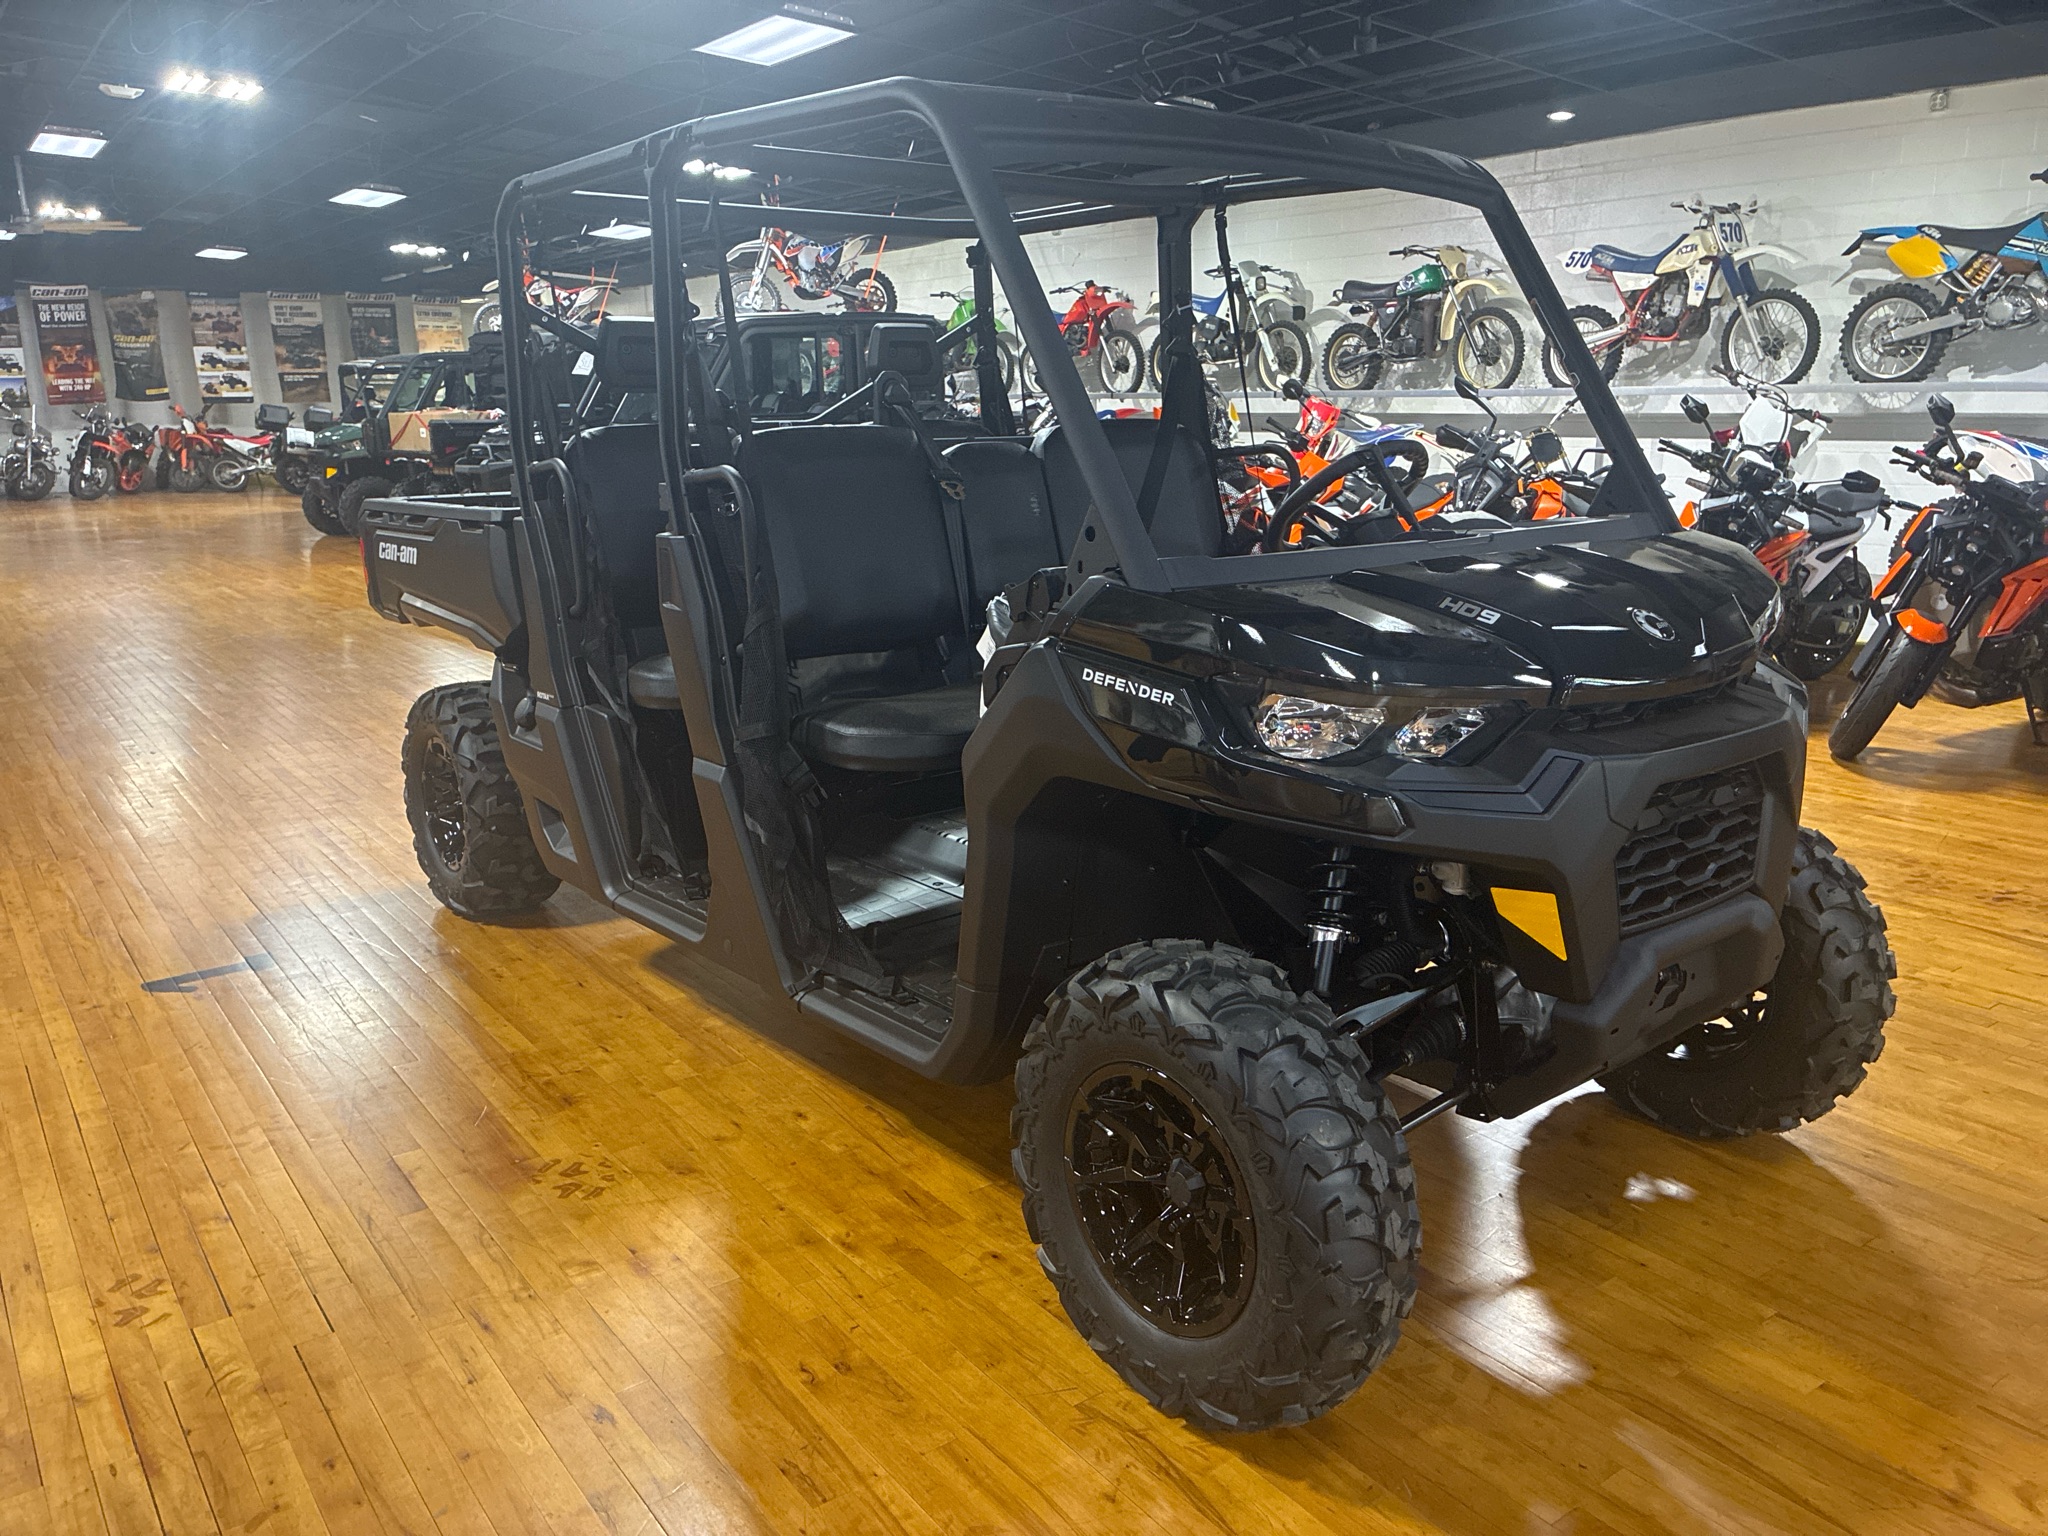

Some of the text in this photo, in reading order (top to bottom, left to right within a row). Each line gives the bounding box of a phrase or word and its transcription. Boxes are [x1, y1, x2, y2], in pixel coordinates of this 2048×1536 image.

[1719, 222, 1743, 243] 570
[1921, 226, 1942, 239] KTM
[1565, 251, 1592, 268] 570
[32, 288, 87, 296] can-am
[269, 291, 318, 300] can-am
[346, 292, 394, 300] can-am
[413, 295, 459, 304] can-am
[40, 311, 86, 322] OF POWER
[52, 378, 73, 386] LEADING
[378, 541, 418, 566] can-am
[1438, 596, 1501, 625] HD9
[1081, 667, 1176, 707] DEFENDER
